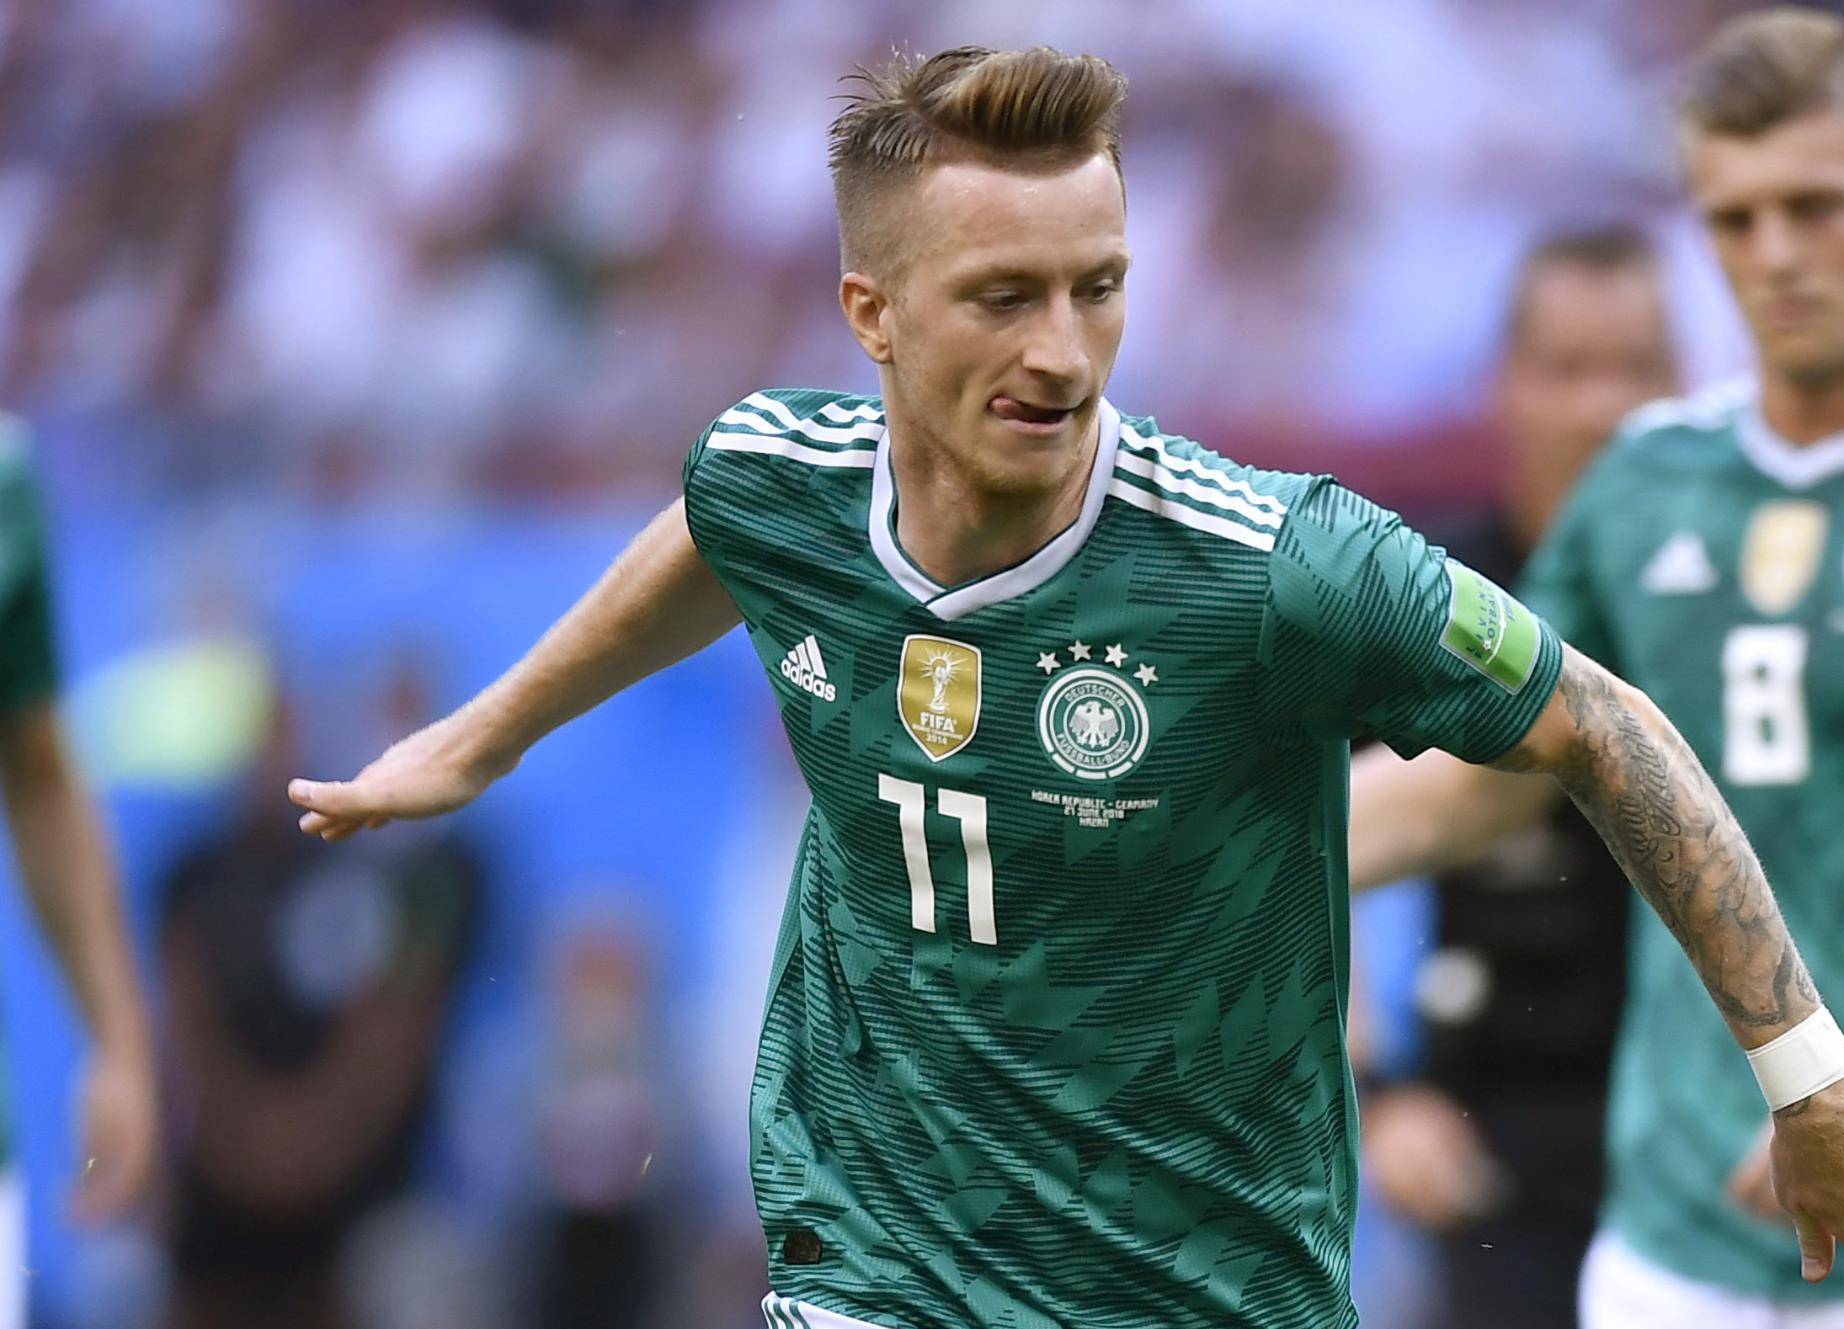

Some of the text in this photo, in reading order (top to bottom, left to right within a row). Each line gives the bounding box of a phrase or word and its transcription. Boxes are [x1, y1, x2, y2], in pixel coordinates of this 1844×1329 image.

[781, 659, 836, 702] adidas
[1064, 685, 1126, 709] DEUTSCHER
[1724, 625, 1809, 785] 8
[920, 712, 955, 733] FIFA
[1062, 795, 1106, 809] REPUBLIC
[1115, 799, 1159, 810] GERMANY
[878, 773, 997, 945] 11
